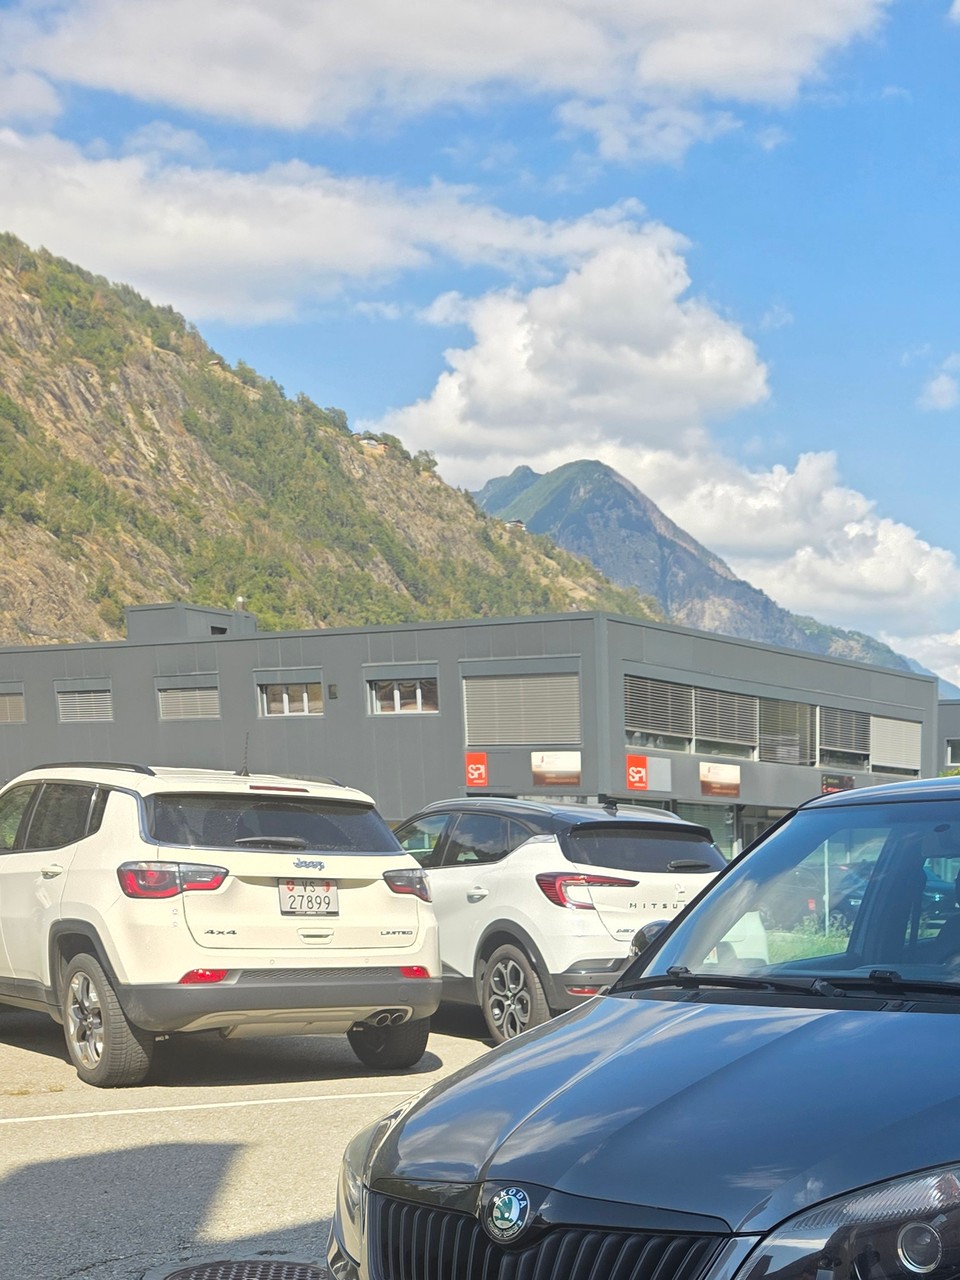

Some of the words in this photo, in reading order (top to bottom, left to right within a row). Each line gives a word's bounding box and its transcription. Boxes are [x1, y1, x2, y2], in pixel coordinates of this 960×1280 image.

[468, 765, 485, 779] SPI
[629, 767, 646, 782] SPI
[293, 858, 325, 871] Jeep
[302, 881, 316, 892] VS
[289, 895, 331, 910] 27899
